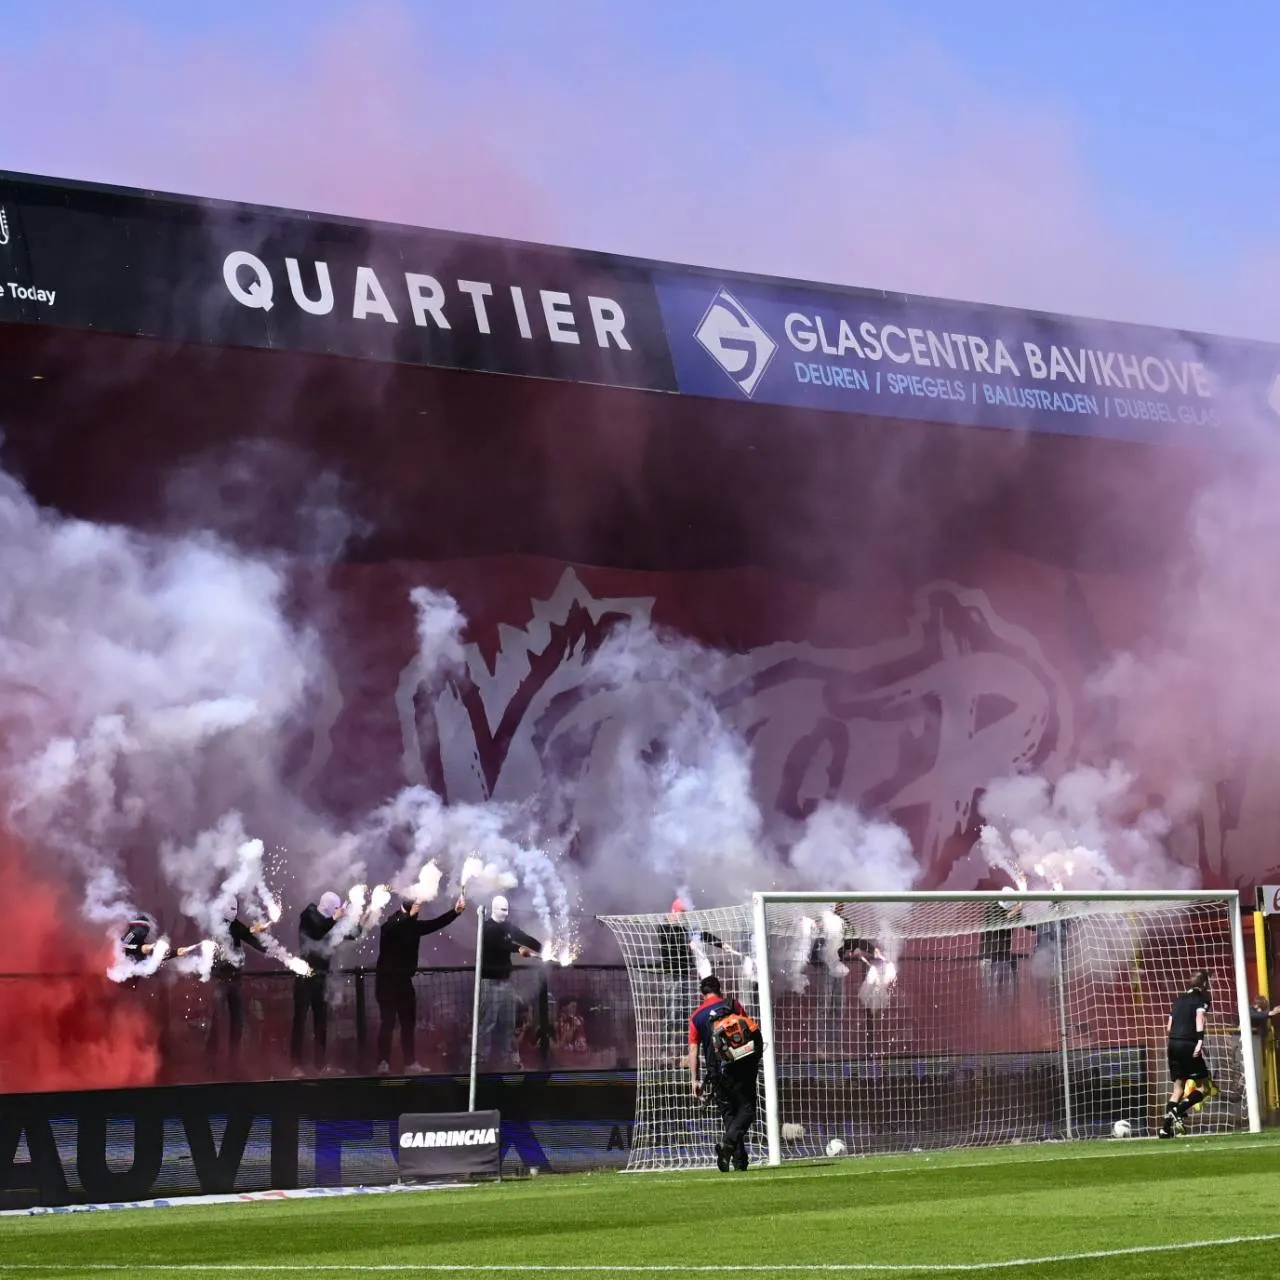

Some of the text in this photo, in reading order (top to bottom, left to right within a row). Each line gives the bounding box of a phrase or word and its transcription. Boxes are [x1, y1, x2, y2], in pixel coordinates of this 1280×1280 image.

[8, 282, 56, 305] Today
[223, 250, 632, 350] QUARTIER
[785, 312, 1212, 398] GLASCENTRA BAVIKHOVE
[793, 361, 869, 391] DEUREN
[887, 372, 966, 401] SPIEGELS
[983, 383, 1099, 415] BALUSTRADEN
[1114, 397, 1176, 422] DUBBEL
[400, 1127, 499, 1148] GARRINCHA
